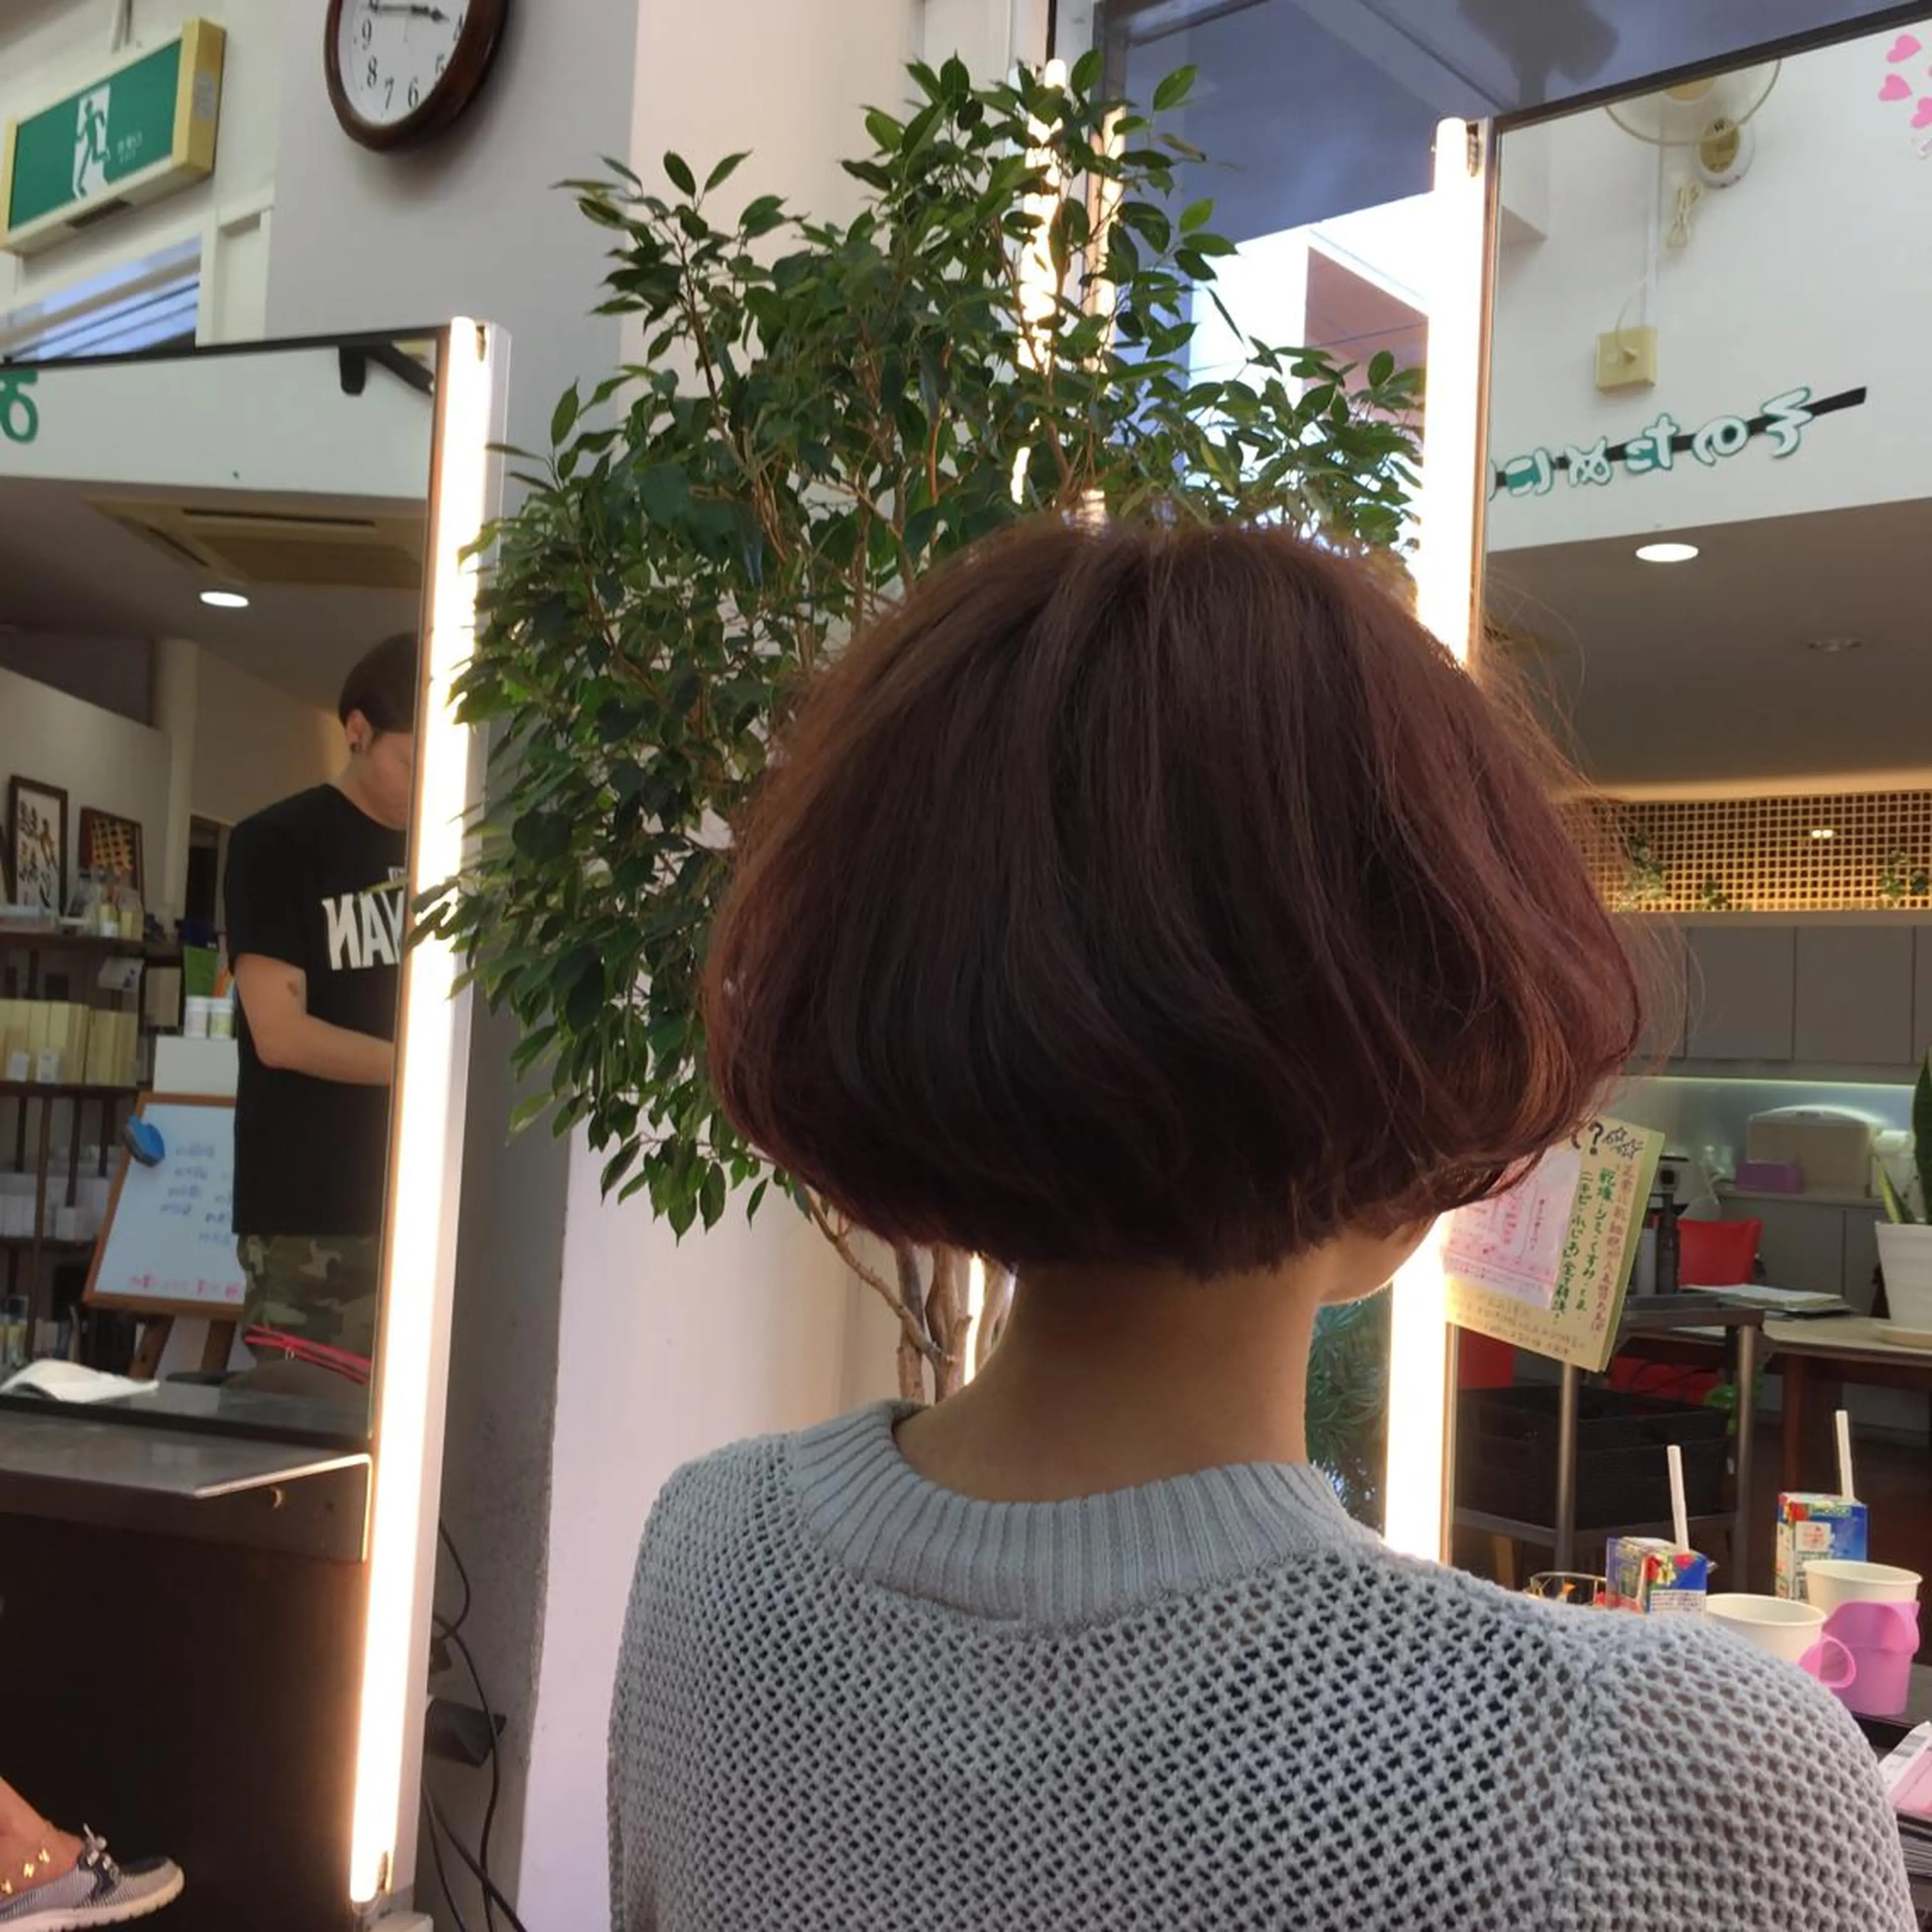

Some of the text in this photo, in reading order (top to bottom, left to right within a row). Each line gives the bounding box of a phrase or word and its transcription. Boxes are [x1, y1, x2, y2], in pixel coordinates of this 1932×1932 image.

[362, 18, 372, 50] 9
[367, 54, 377, 89] 8
[384, 76, 394, 109] 7
[408, 75, 419, 109] 6
